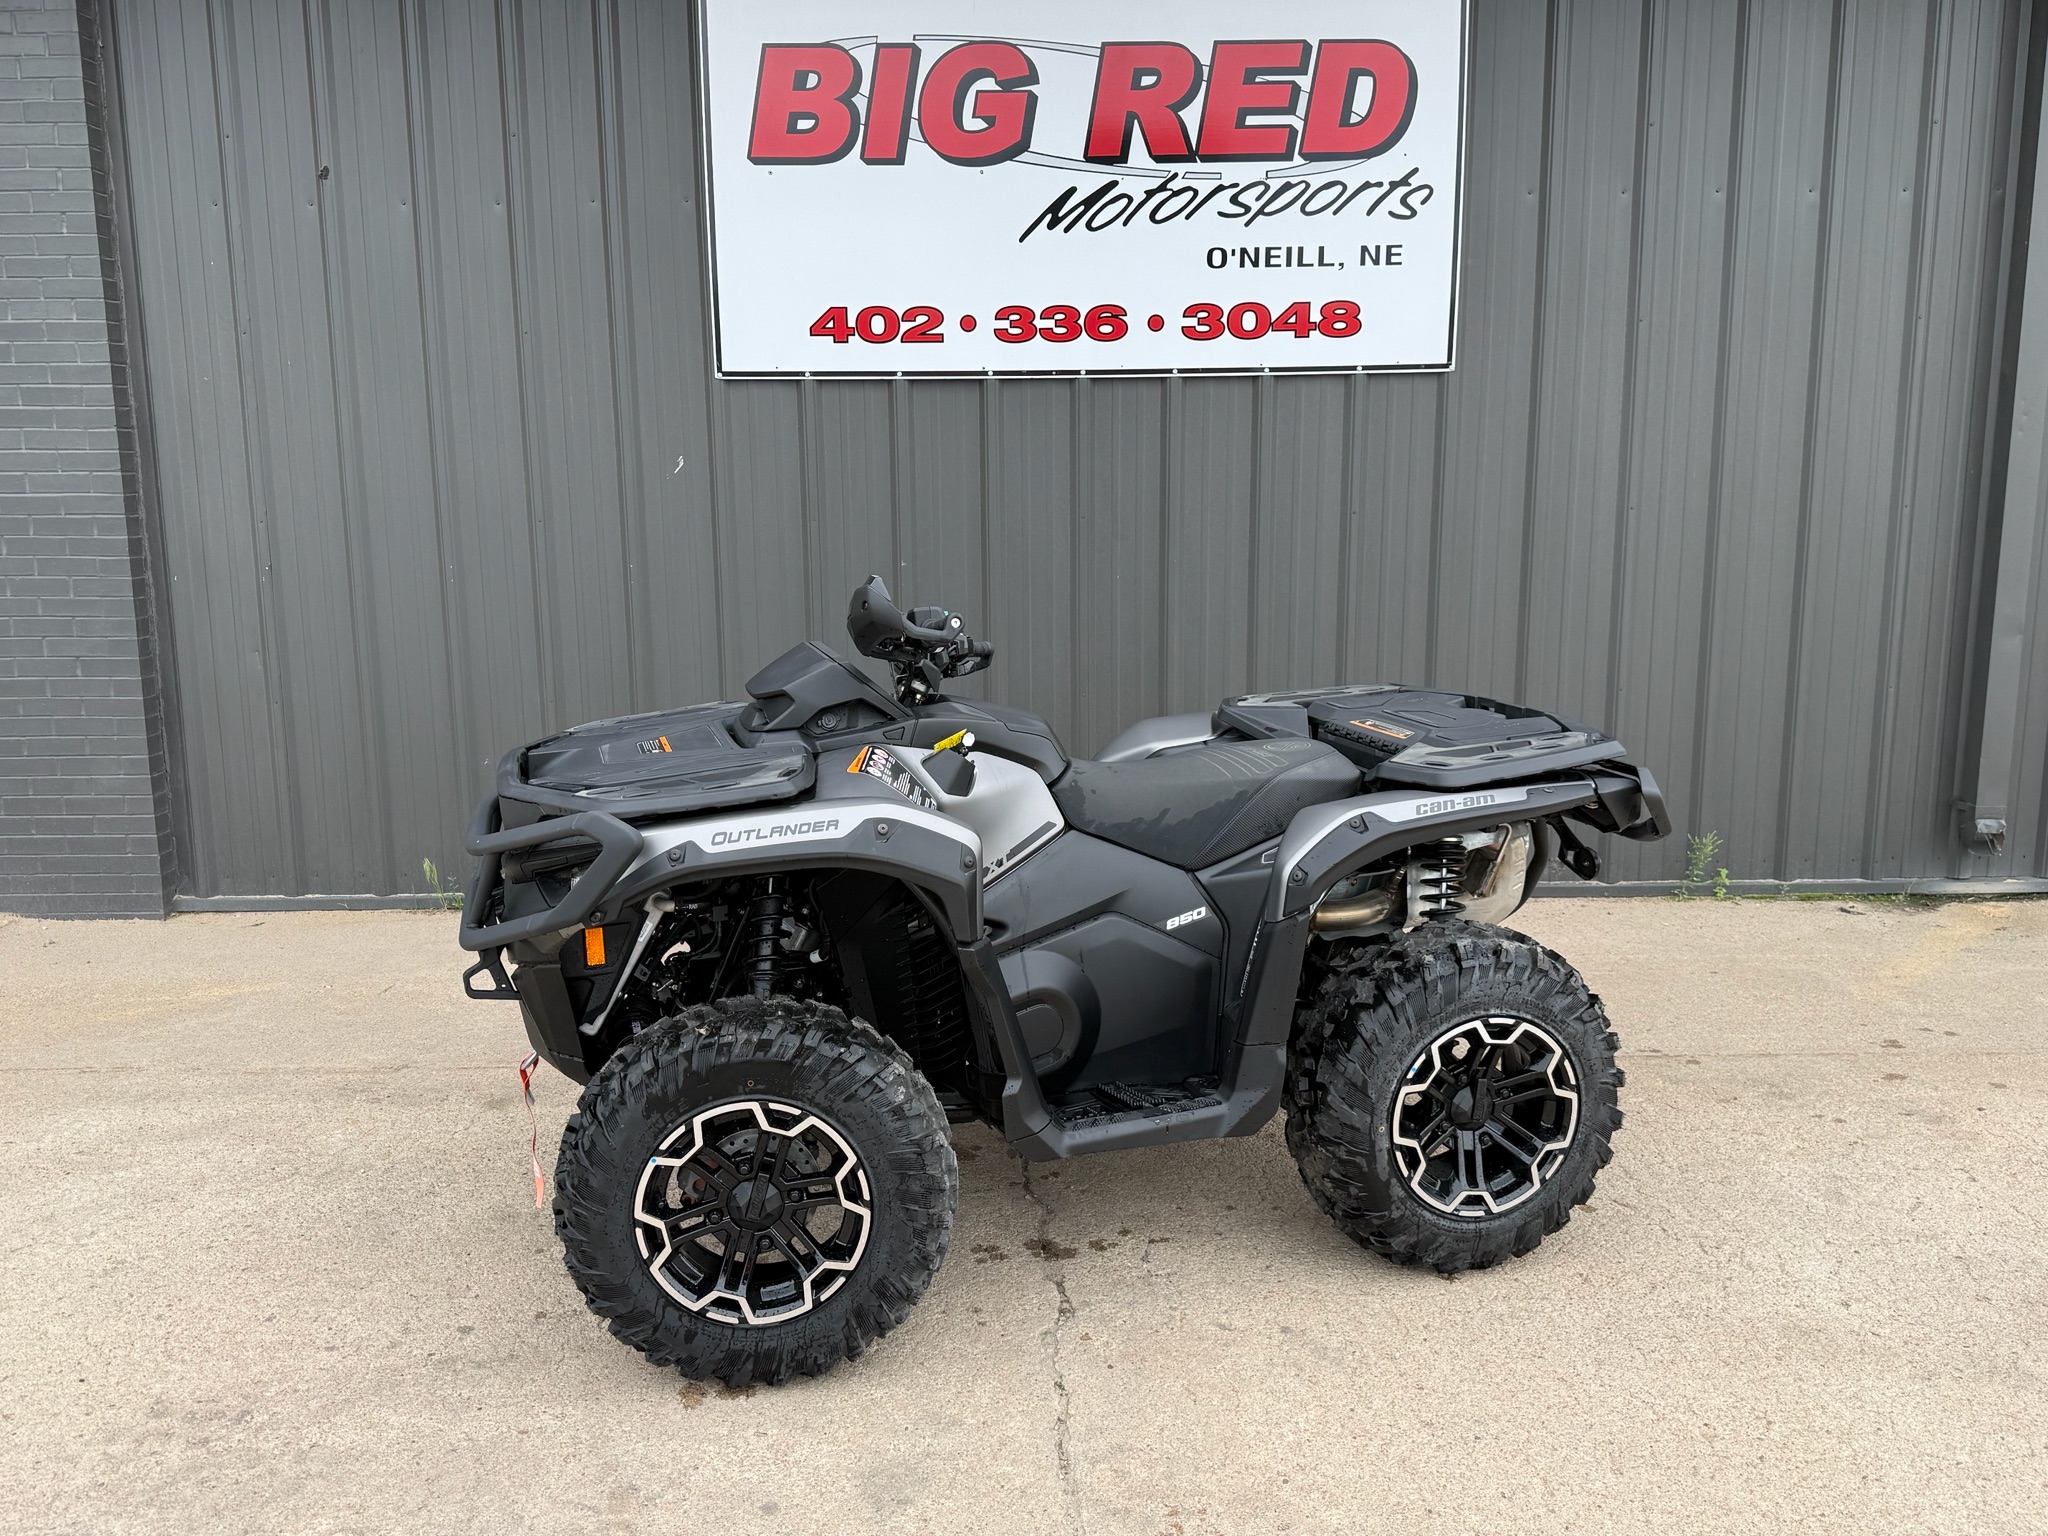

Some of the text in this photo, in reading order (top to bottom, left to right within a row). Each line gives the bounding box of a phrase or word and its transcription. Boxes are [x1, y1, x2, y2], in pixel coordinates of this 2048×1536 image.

[747, 38, 1419, 167] BIG RED
[1018, 167, 1434, 243] Motorsports
[1206, 244, 1403, 270] O'NEILL, NE
[809, 301, 1362, 344] 402 336 3048
[1415, 794, 1496, 816] can-am
[711, 819, 840, 846] OUTLANDER
[1166, 906, 1206, 930] 850
